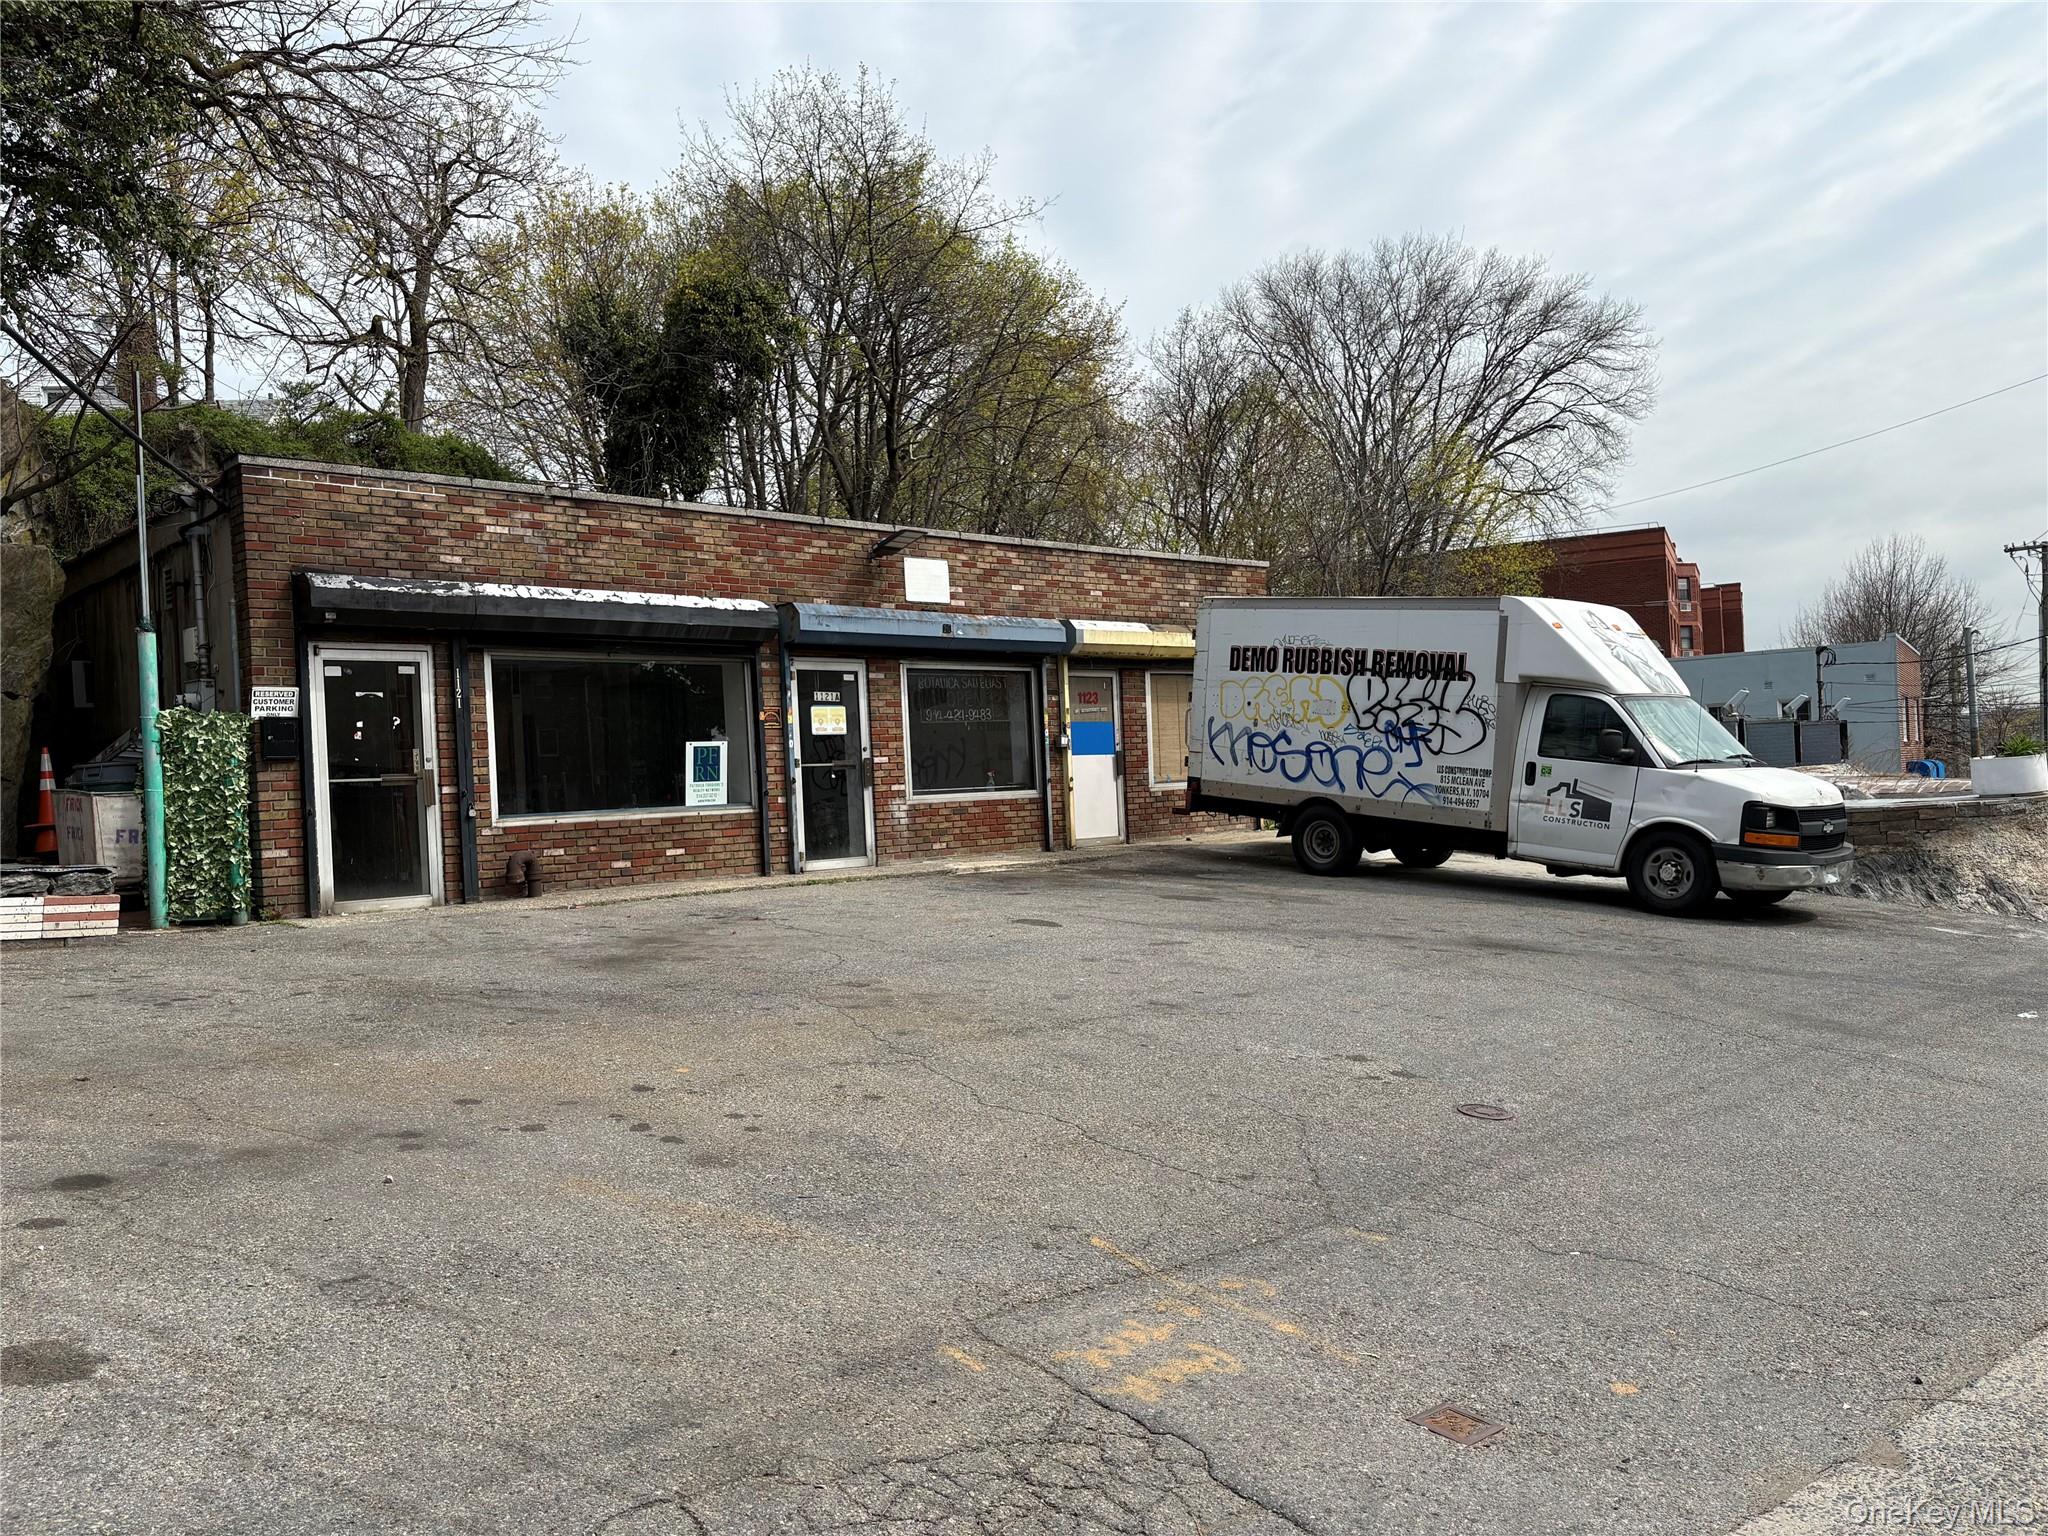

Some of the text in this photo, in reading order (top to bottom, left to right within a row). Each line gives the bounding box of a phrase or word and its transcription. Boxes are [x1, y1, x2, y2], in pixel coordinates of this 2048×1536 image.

[1229, 644, 1468, 682] DEMO RUBBISH REMOVAL
[254, 690, 295, 698] RESERVED
[814, 691, 840, 701] 1121A
[1077, 691, 1099, 705] 1123
[695, 747, 719, 765] PF
[695, 765, 719, 781] RN
[1445, 765, 1479, 777] CONSTRUCTION
[1440, 775, 1486, 788] 815 MCLEAN AVE
[1472, 789, 1490, 799] 10704
[1442, 796, 1480, 809] 914-494-6957
[1543, 798, 1582, 818] LLS
[1542, 815, 1611, 830] CONSTRUCTION
